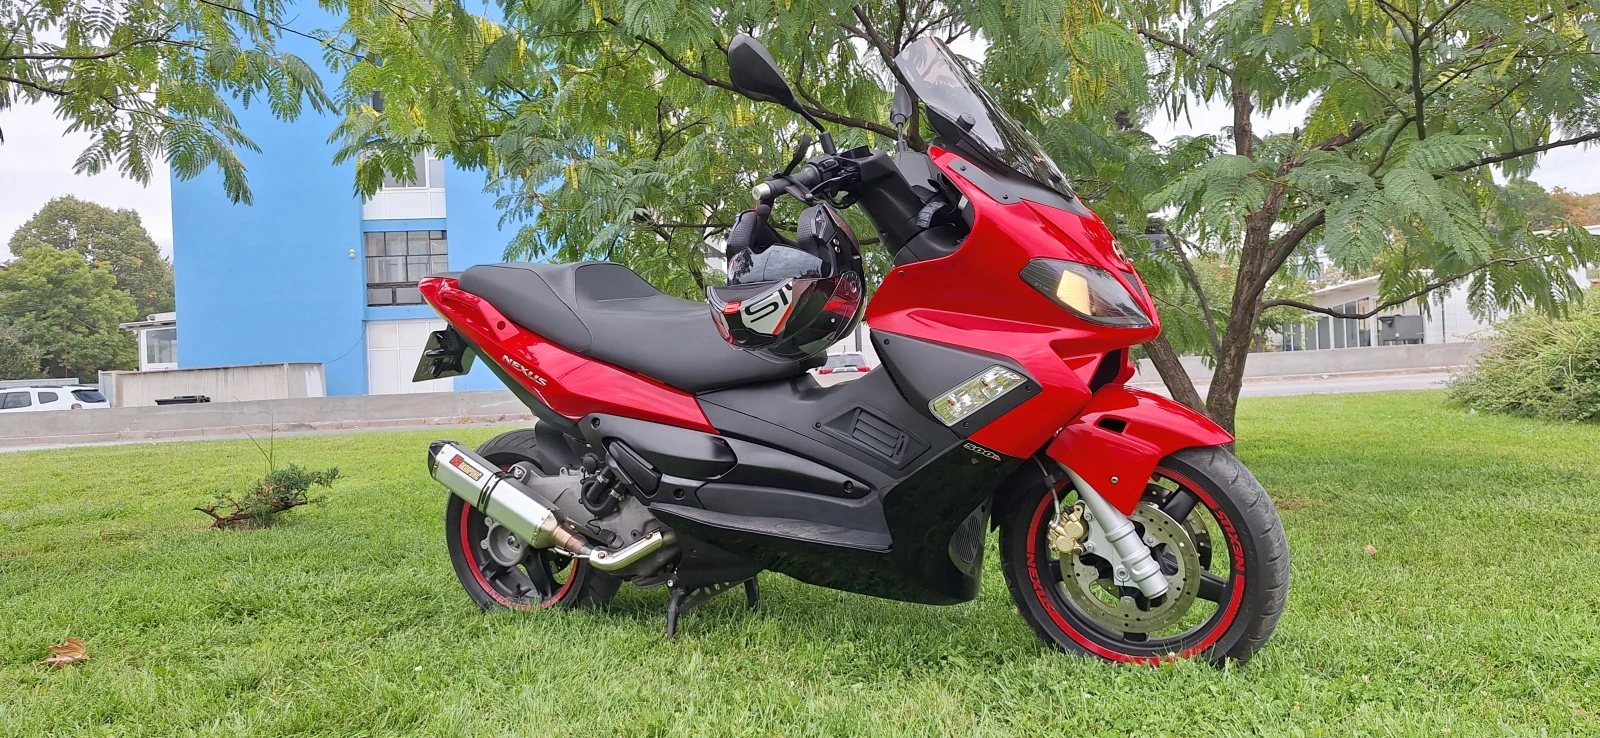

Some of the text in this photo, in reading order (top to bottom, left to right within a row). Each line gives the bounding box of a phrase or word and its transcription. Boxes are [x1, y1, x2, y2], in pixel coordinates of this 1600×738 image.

[502, 354, 547, 387] NEXUS
[1214, 510, 1245, 572] NEXUS
[1026, 552, 1056, 612] NEXUS
